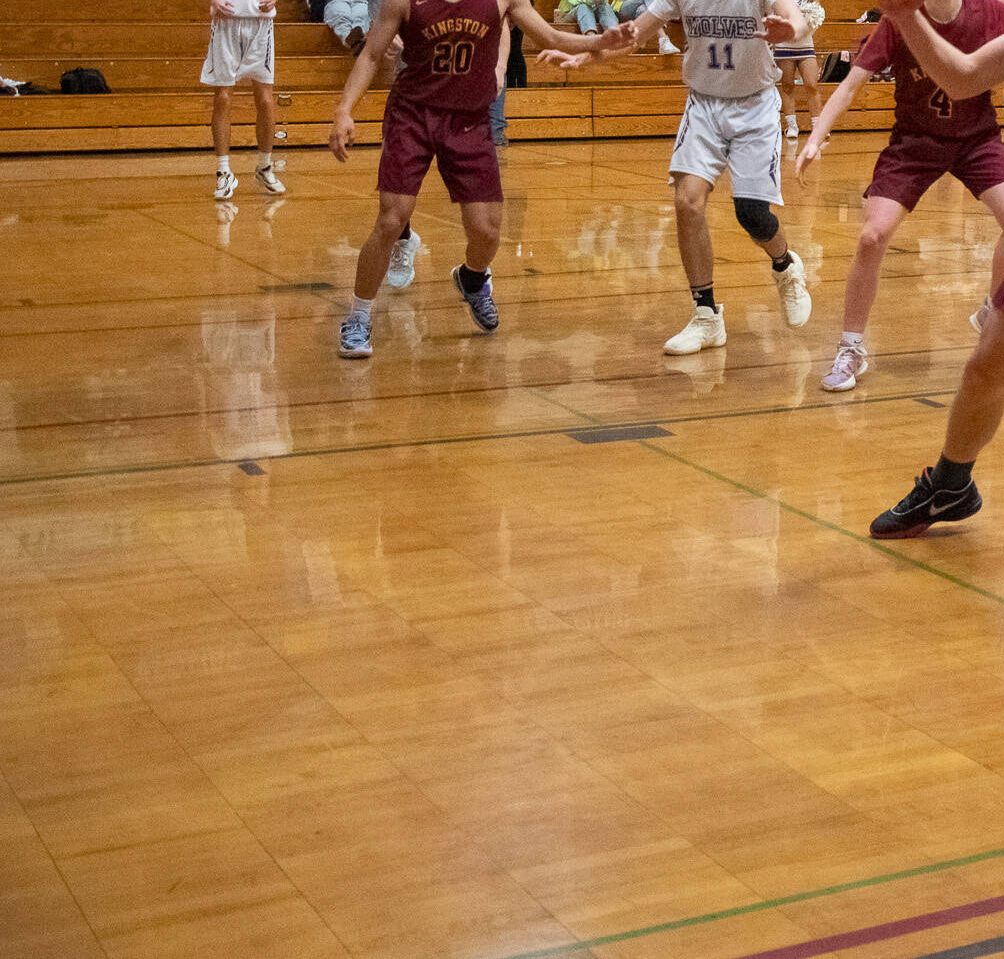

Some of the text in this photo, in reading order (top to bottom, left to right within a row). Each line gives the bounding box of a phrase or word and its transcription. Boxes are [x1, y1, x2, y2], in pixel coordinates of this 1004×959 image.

[422, 18, 489, 40] KINGSTON
[685, 16, 757, 39] WOLVES
[432, 41, 475, 75] 20
[708, 44, 735, 70] 11
[929, 87, 952, 118] 4
